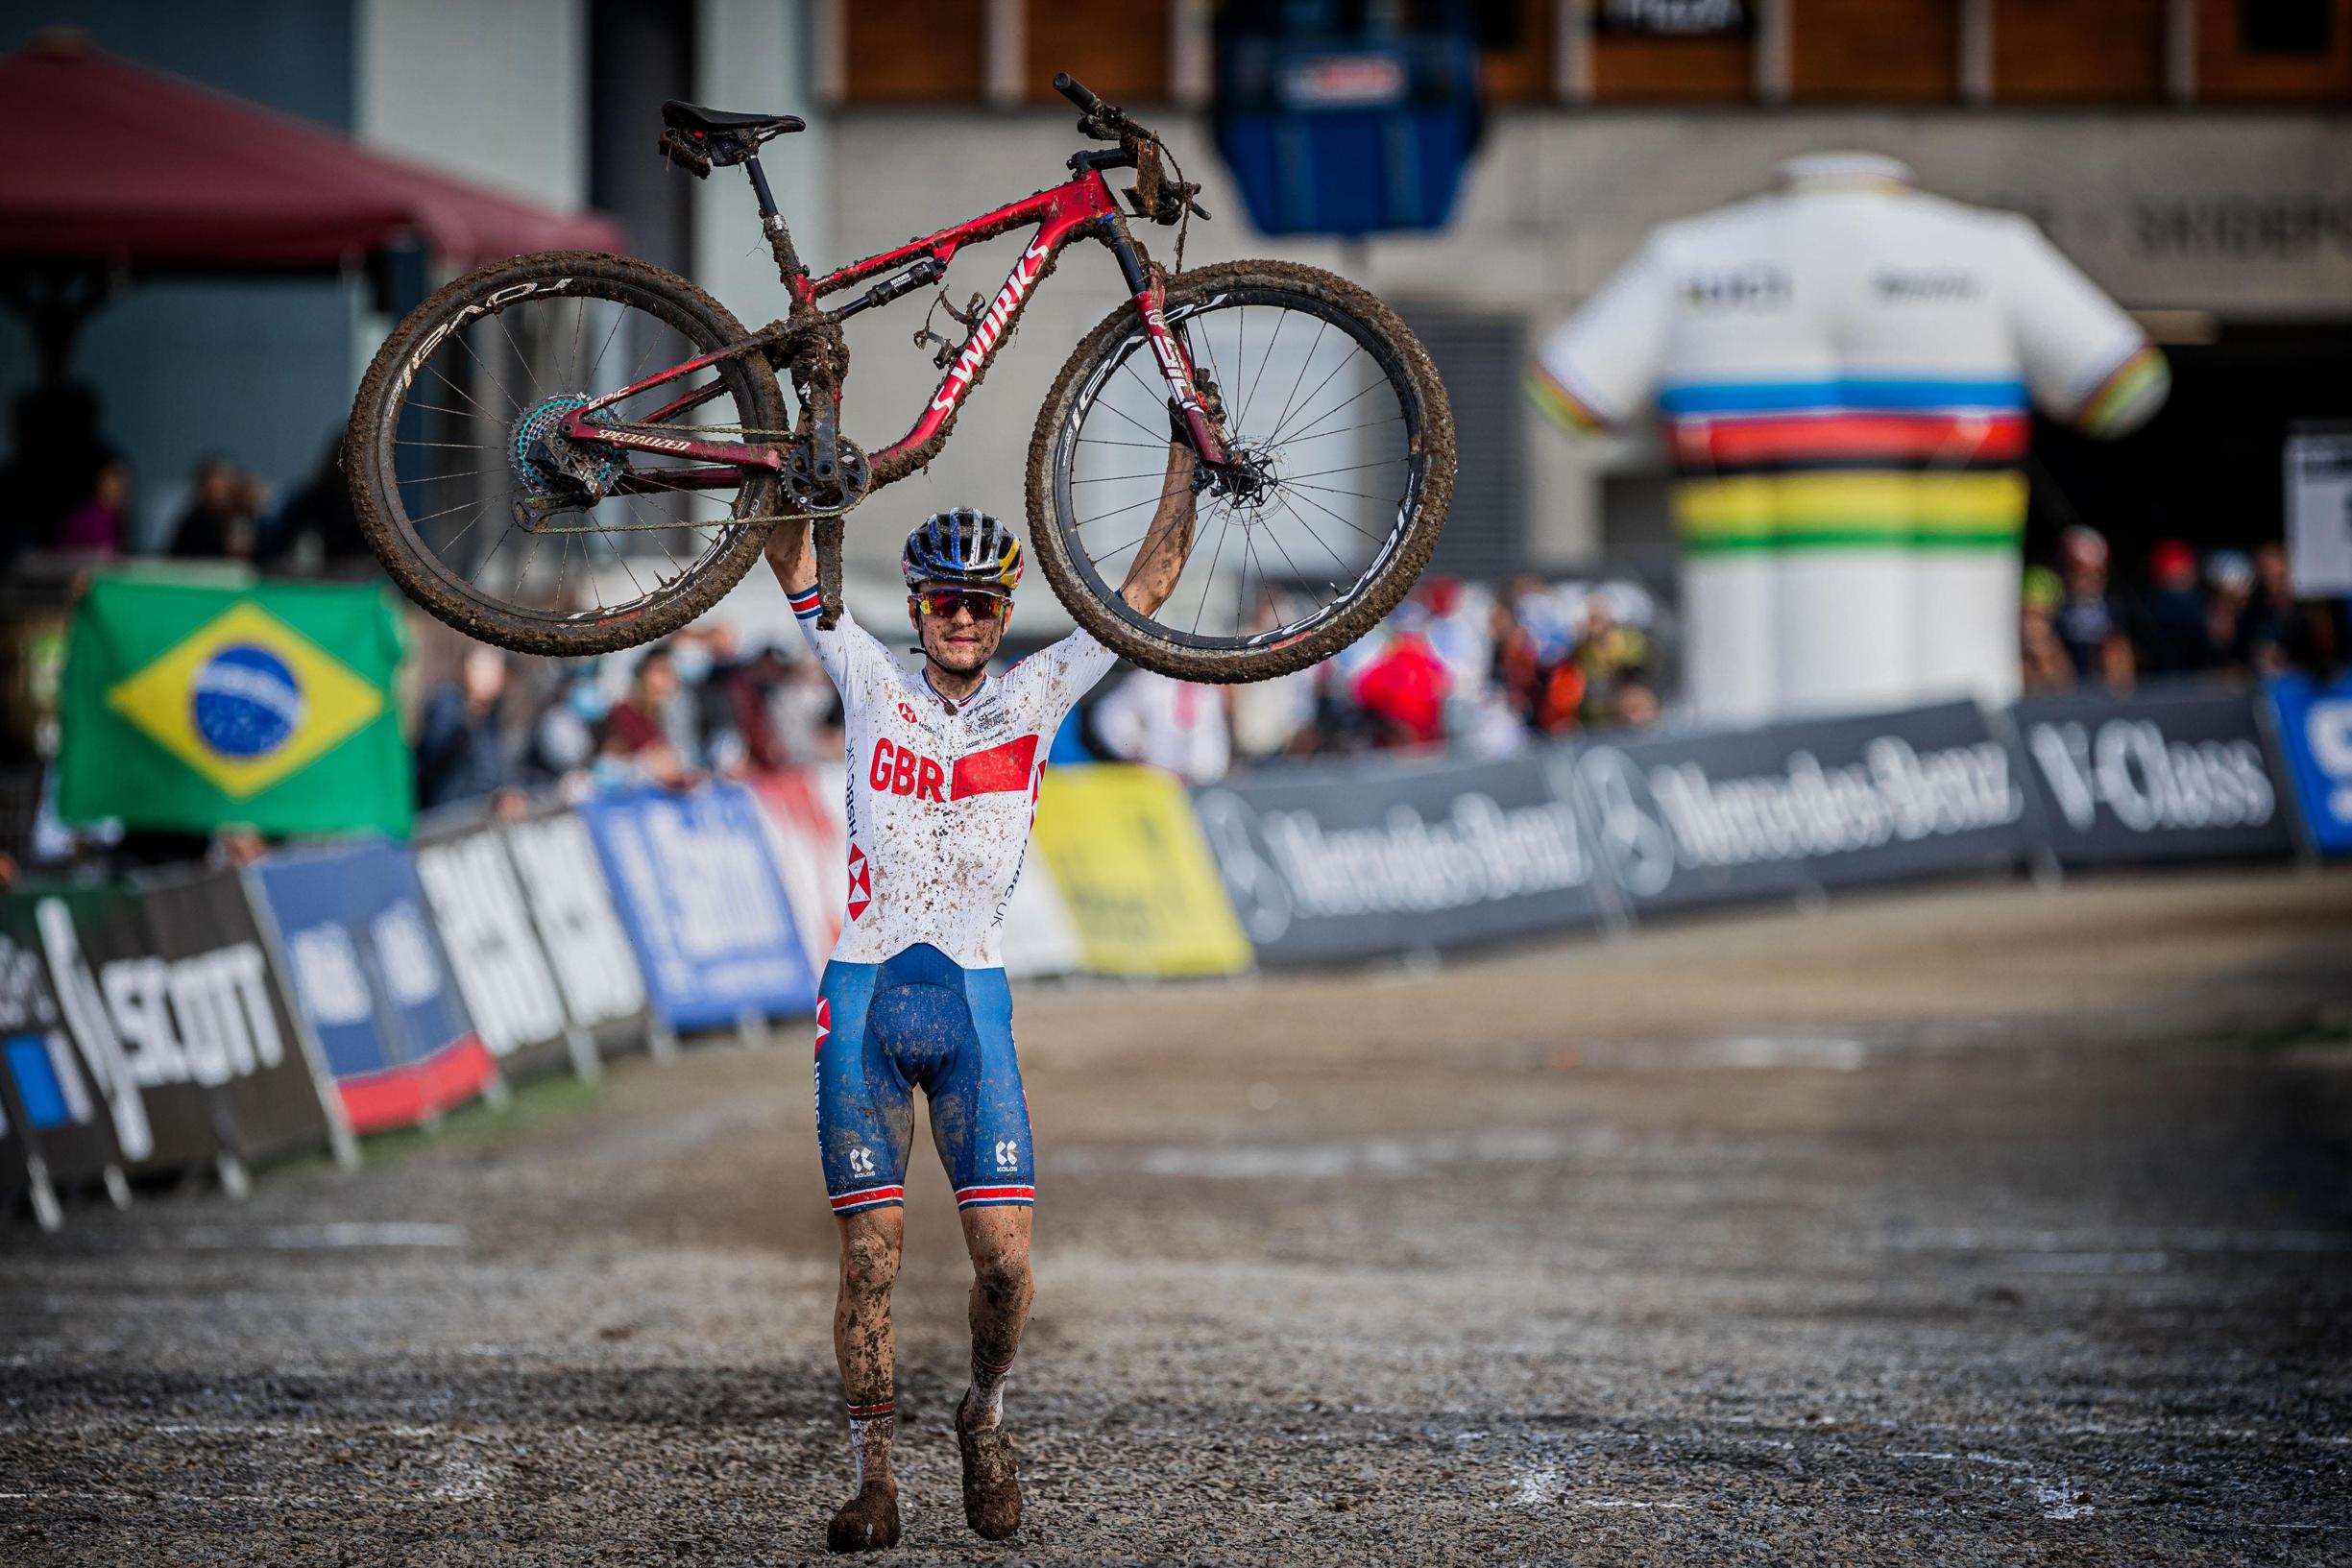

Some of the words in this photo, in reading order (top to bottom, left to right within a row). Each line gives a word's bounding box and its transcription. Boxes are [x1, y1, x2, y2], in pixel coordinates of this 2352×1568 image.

[932, 234, 1050, 425] S-WORKS
[588, 386, 630, 410] EPIC
[594, 429, 691, 450] SPECIALIZED
[918, 721, 937, 736] HSBC
[869, 737, 946, 804] GBR
[2029, 719, 2276, 832] V-Class
[846, 773, 858, 838] HSBC
[990, 902, 1007, 929] UK
